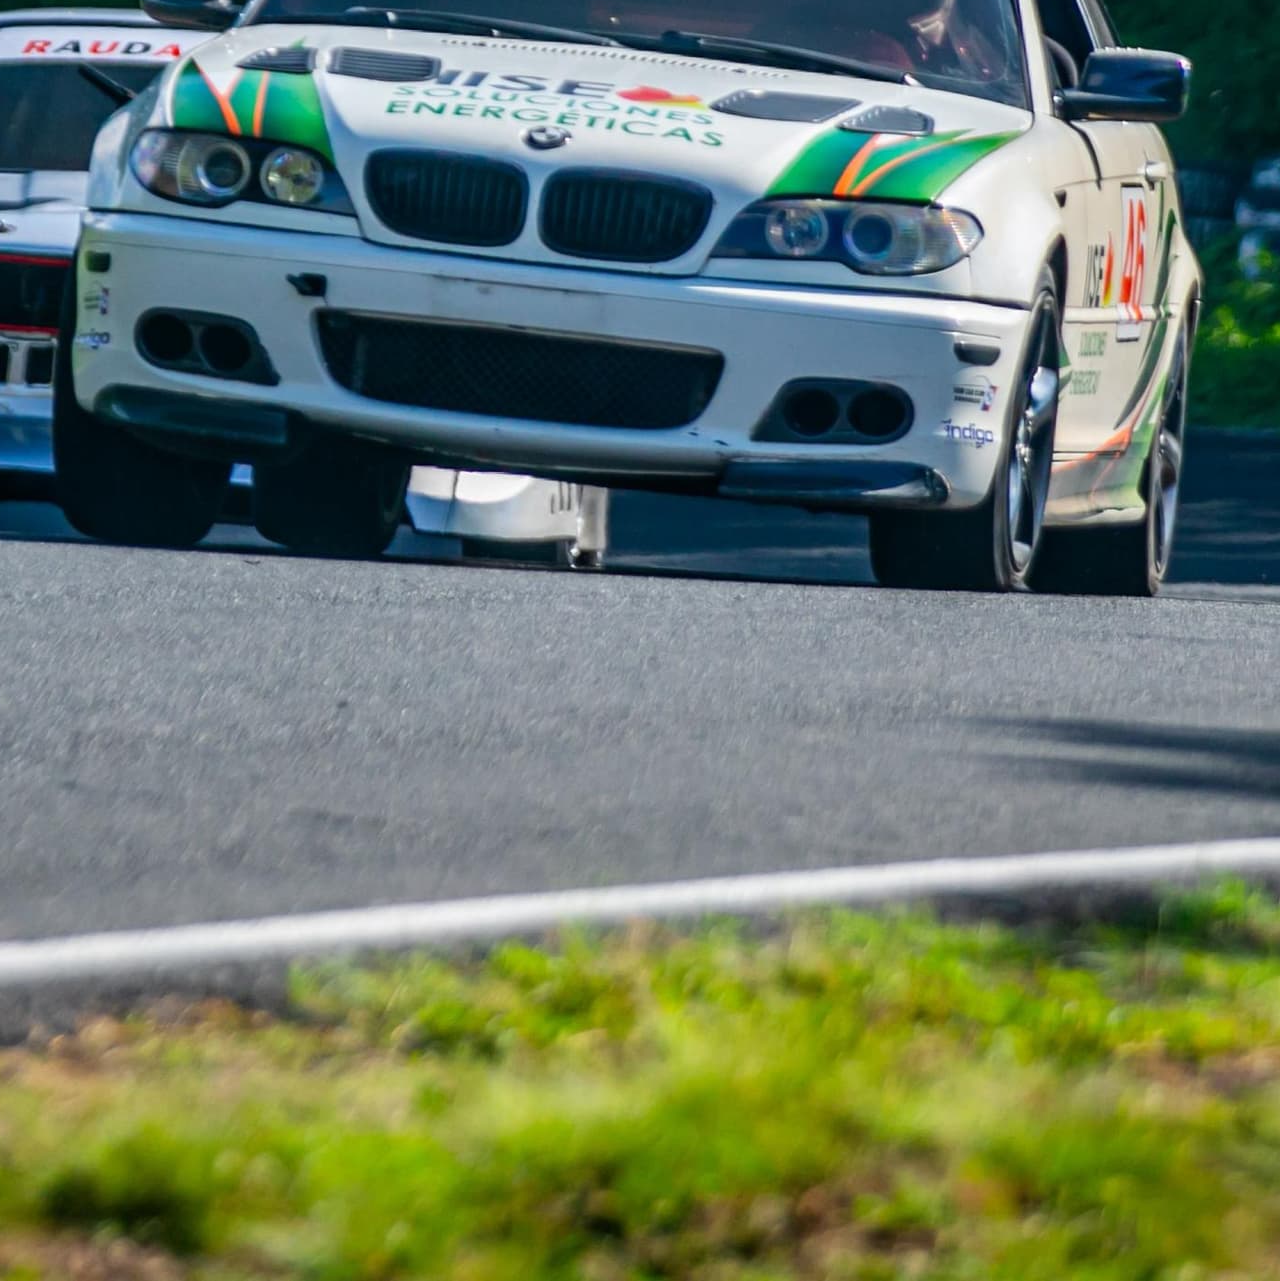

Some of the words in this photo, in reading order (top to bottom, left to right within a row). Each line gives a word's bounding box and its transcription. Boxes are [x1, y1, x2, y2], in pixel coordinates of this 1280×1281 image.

[22, 39, 182, 57] RAUDA
[393, 86, 713, 125] SOLUCIONES
[1120, 198, 1146, 324] 46
